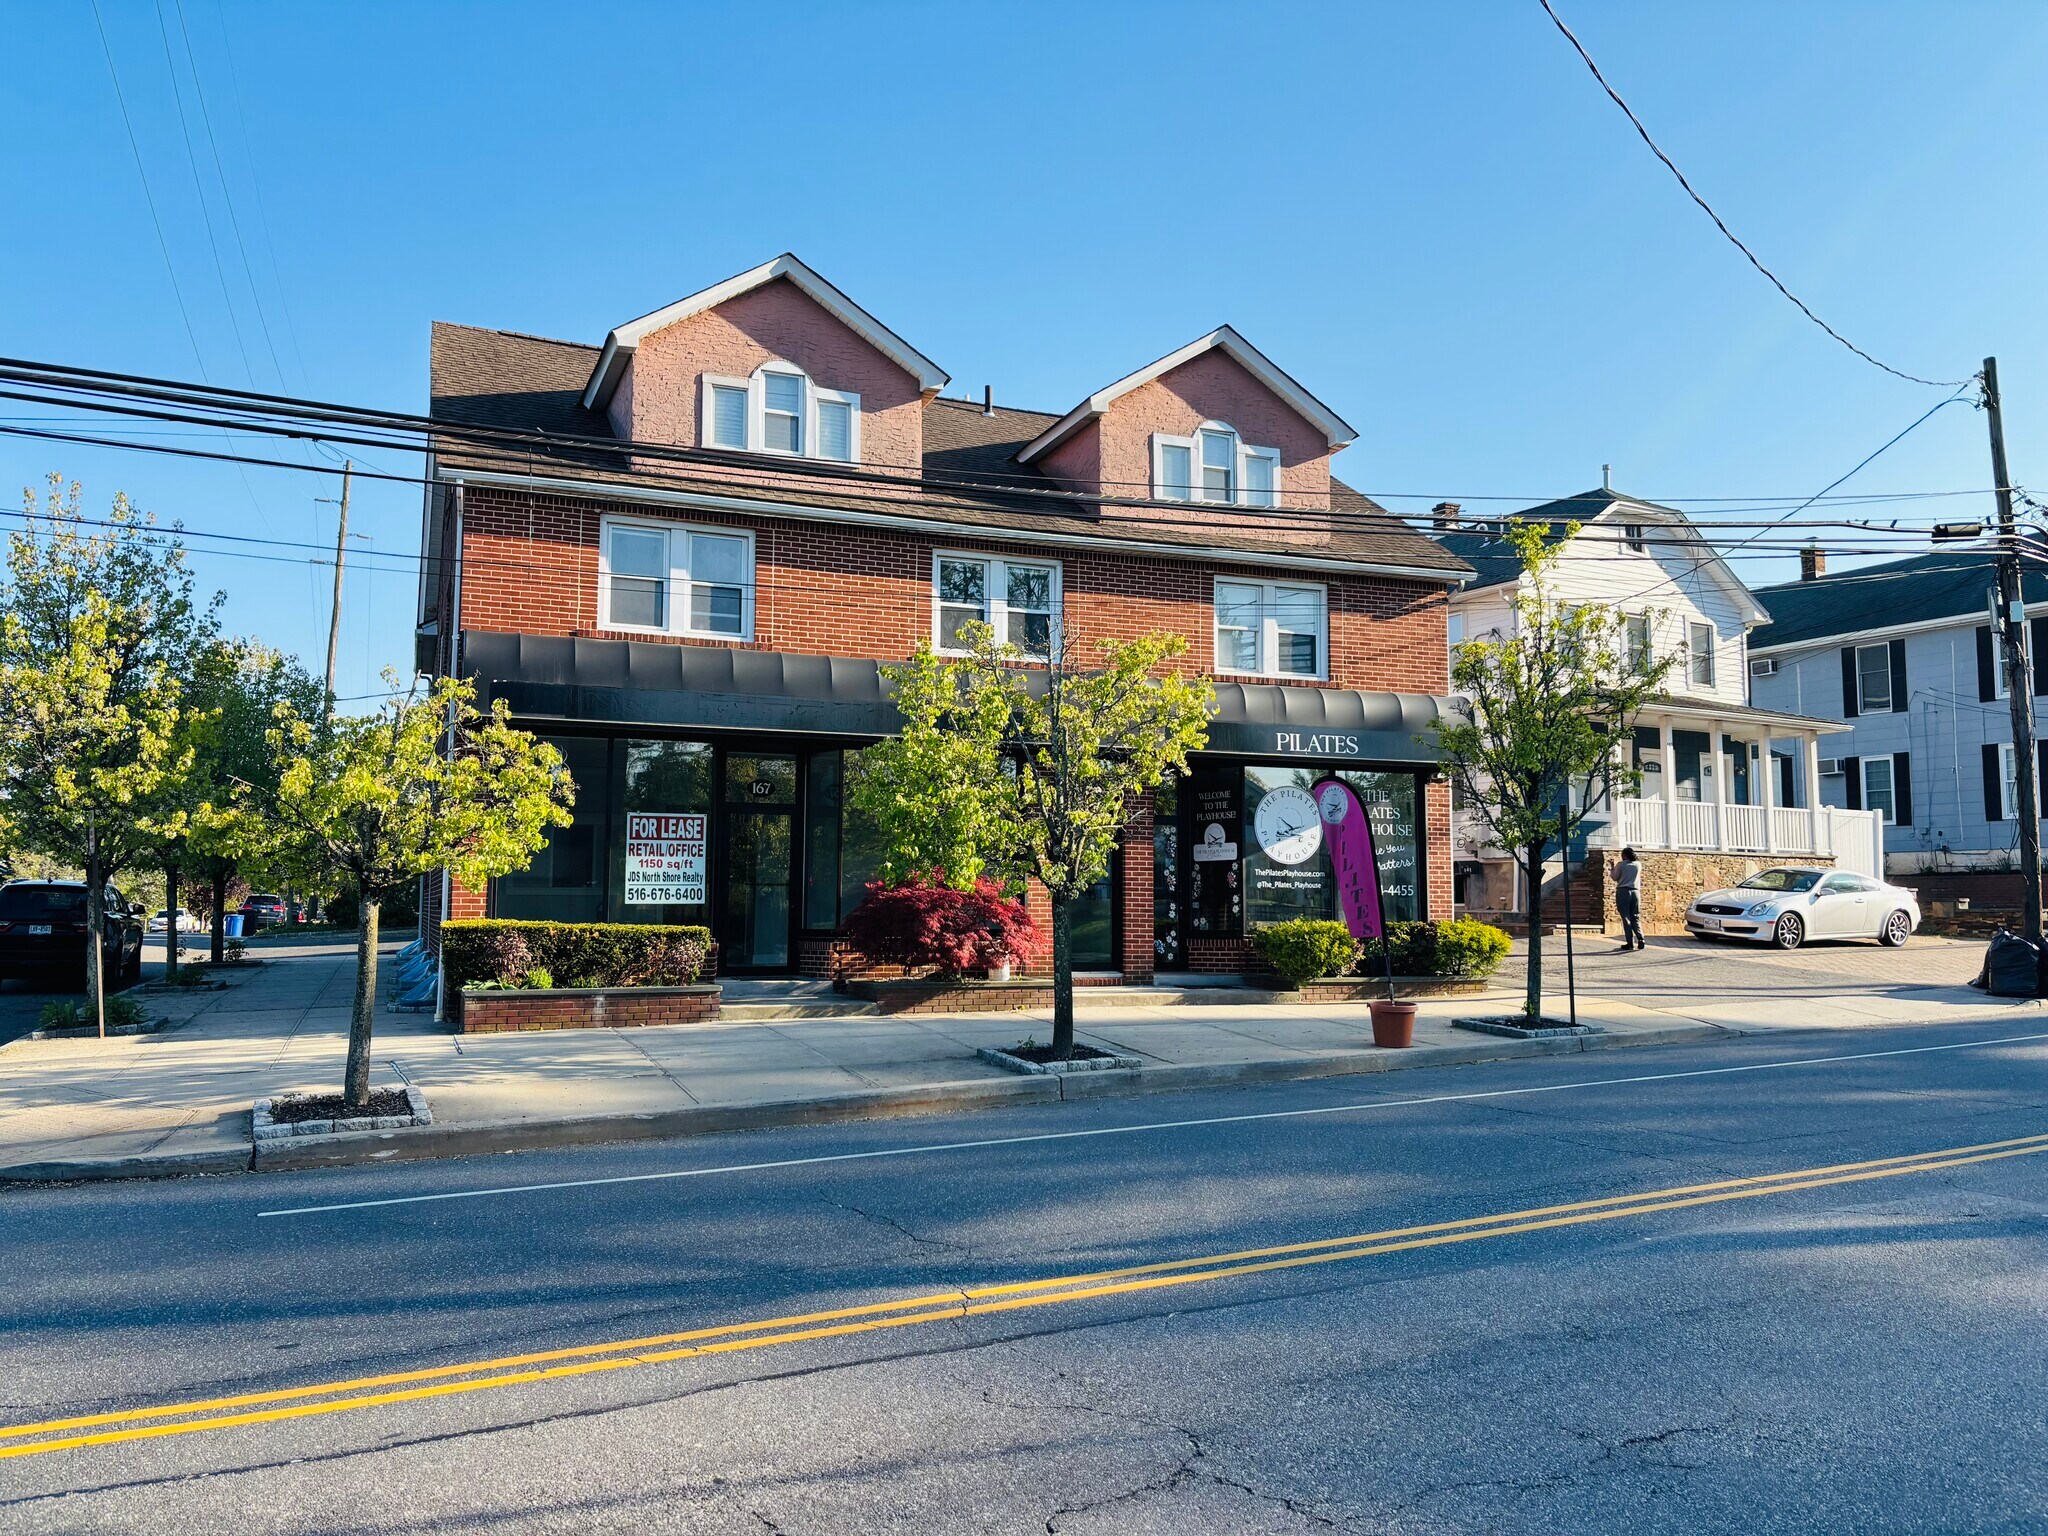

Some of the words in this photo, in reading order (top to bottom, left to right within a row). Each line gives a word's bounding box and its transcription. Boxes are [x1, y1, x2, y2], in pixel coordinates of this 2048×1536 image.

[1276, 732, 1359, 754] PILATES
[752, 782, 771, 794] 167
[1198, 790, 1231, 800] WELCOME
[1259, 794, 1278, 813] THE
[1280, 790, 1318, 816] PILATES
[1366, 789, 1389, 803] THE
[1203, 802, 1214, 810] TO
[1214, 801, 1229, 809] THE
[632, 818, 657, 838] FOR
[661, 818, 702, 839] LEASE
[628, 843, 704, 858] RETAIL/OFFICE
[1261, 830, 1317, 861] PLAYHOUSE
[638, 859, 663, 868] 1150
[667, 859, 693, 870] sq/ft
[628, 871, 640, 882] JDS
[642, 872, 661, 882] North
[662, 872, 681, 882] Shore
[682, 872, 704, 885] Realty
[1254, 868, 1326, 878] ThePilatesPlayhouse.com
[1256, 880, 1322, 890] @The_Pilates_Playhouse
[628, 887, 703, 901] 516-676-6400
